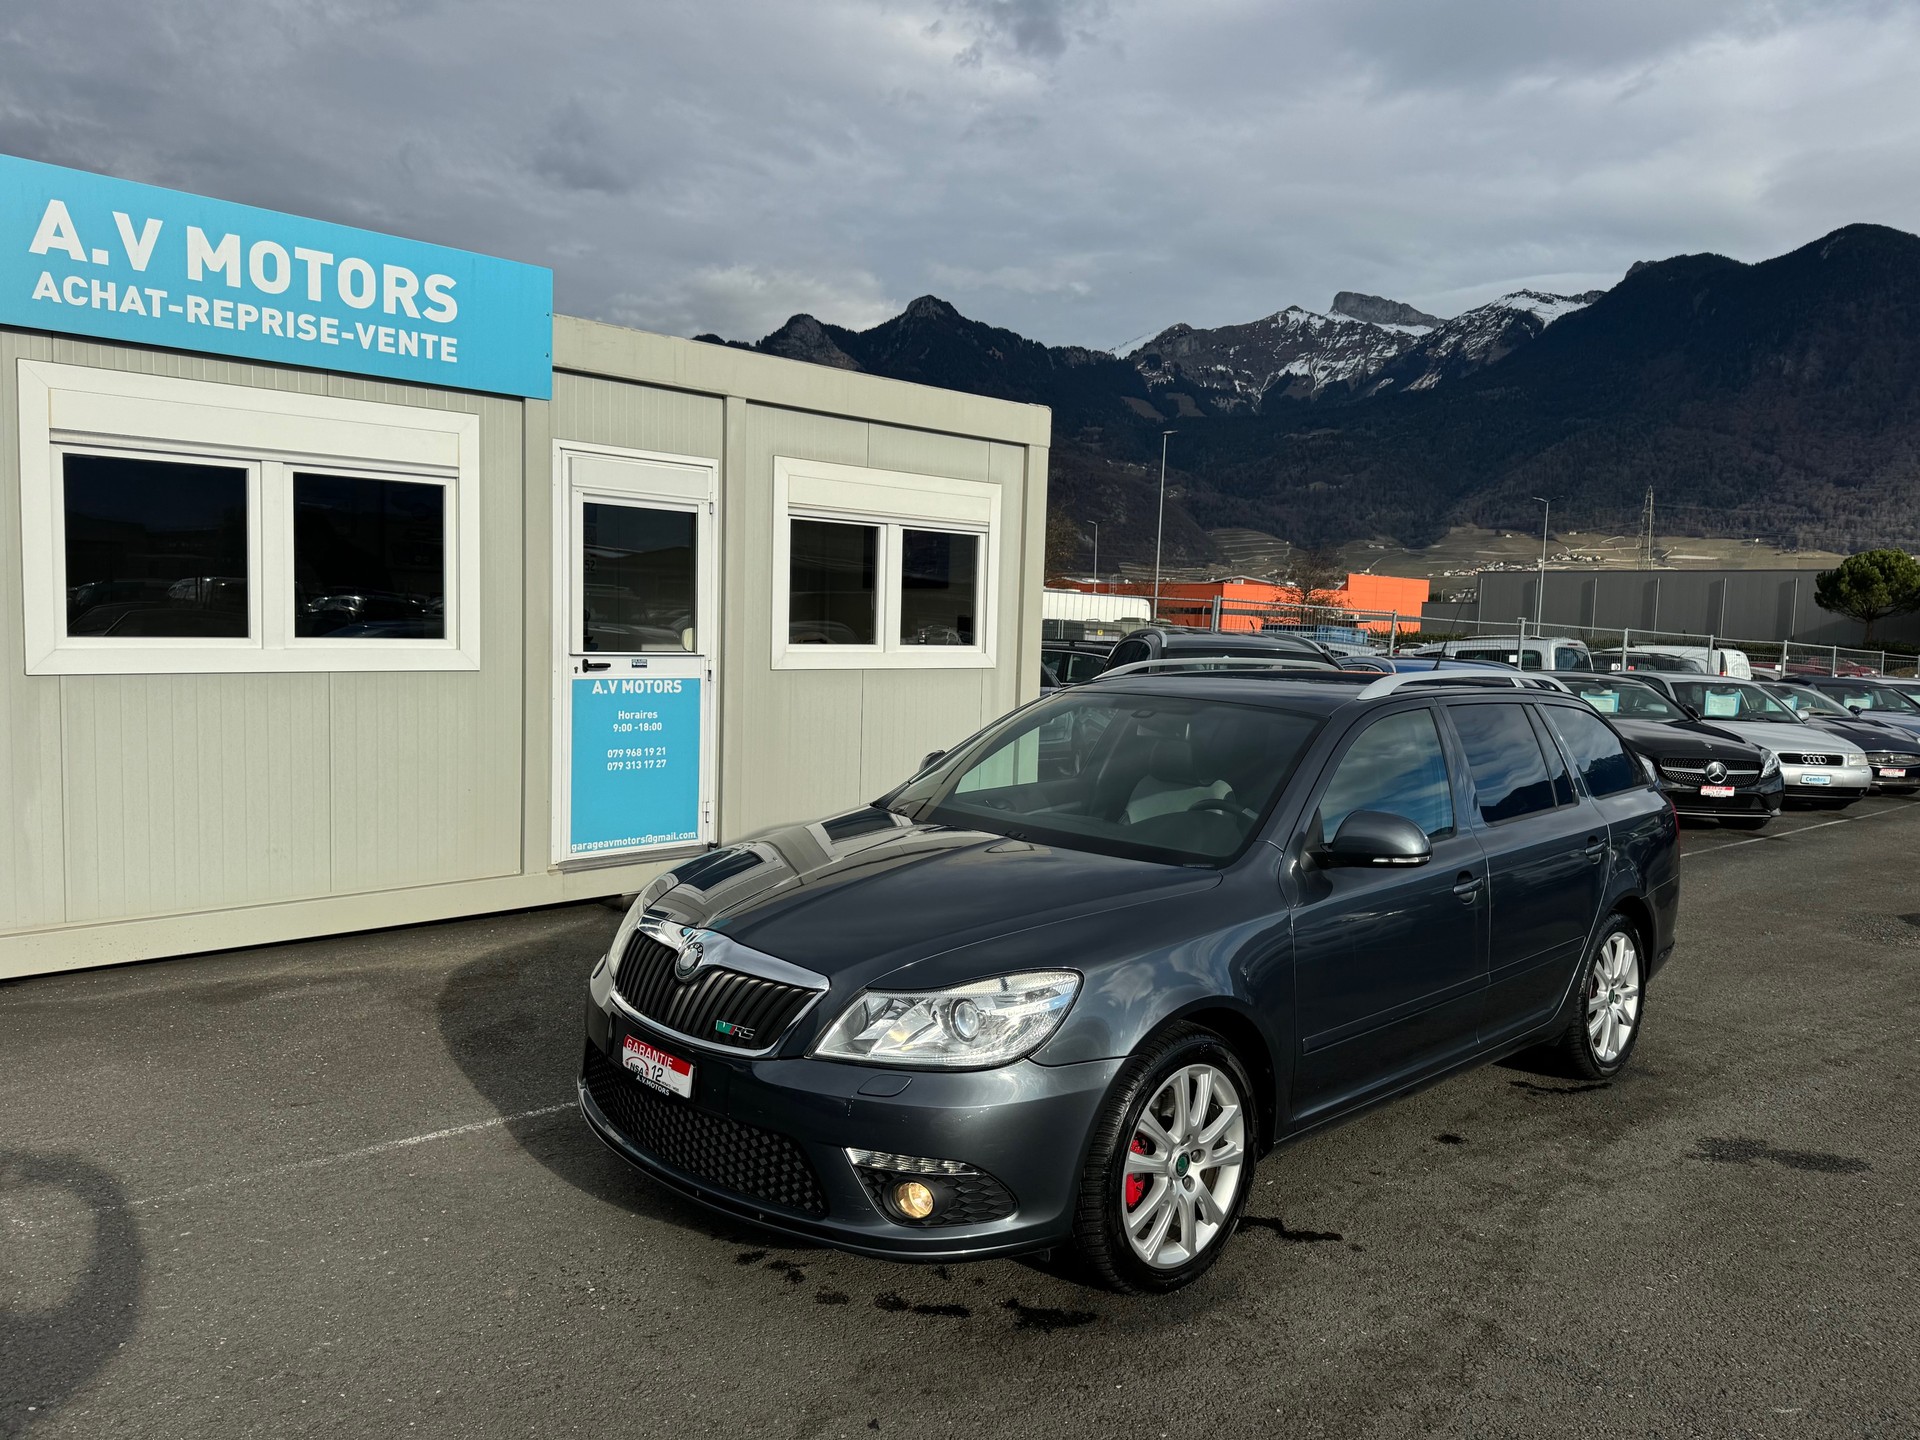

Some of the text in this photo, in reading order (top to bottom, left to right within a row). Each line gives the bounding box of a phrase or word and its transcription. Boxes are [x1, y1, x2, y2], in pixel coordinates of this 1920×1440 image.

[28, 199, 458, 323] A.V MOTORS
[32, 271, 458, 363] ACHAT-REPRISE-VENTE
[592, 679, 682, 694] A.V MOTORS
[618, 710, 658, 720] Horaires
[612, 723, 632, 732] 9:00
[607, 746, 666, 758] 079 968 19 21
[607, 759, 667, 771] 079 313 17 27
[571, 831, 697, 853] garageavmotors@gmail.com
[651, 1064, 664, 1083] 12
